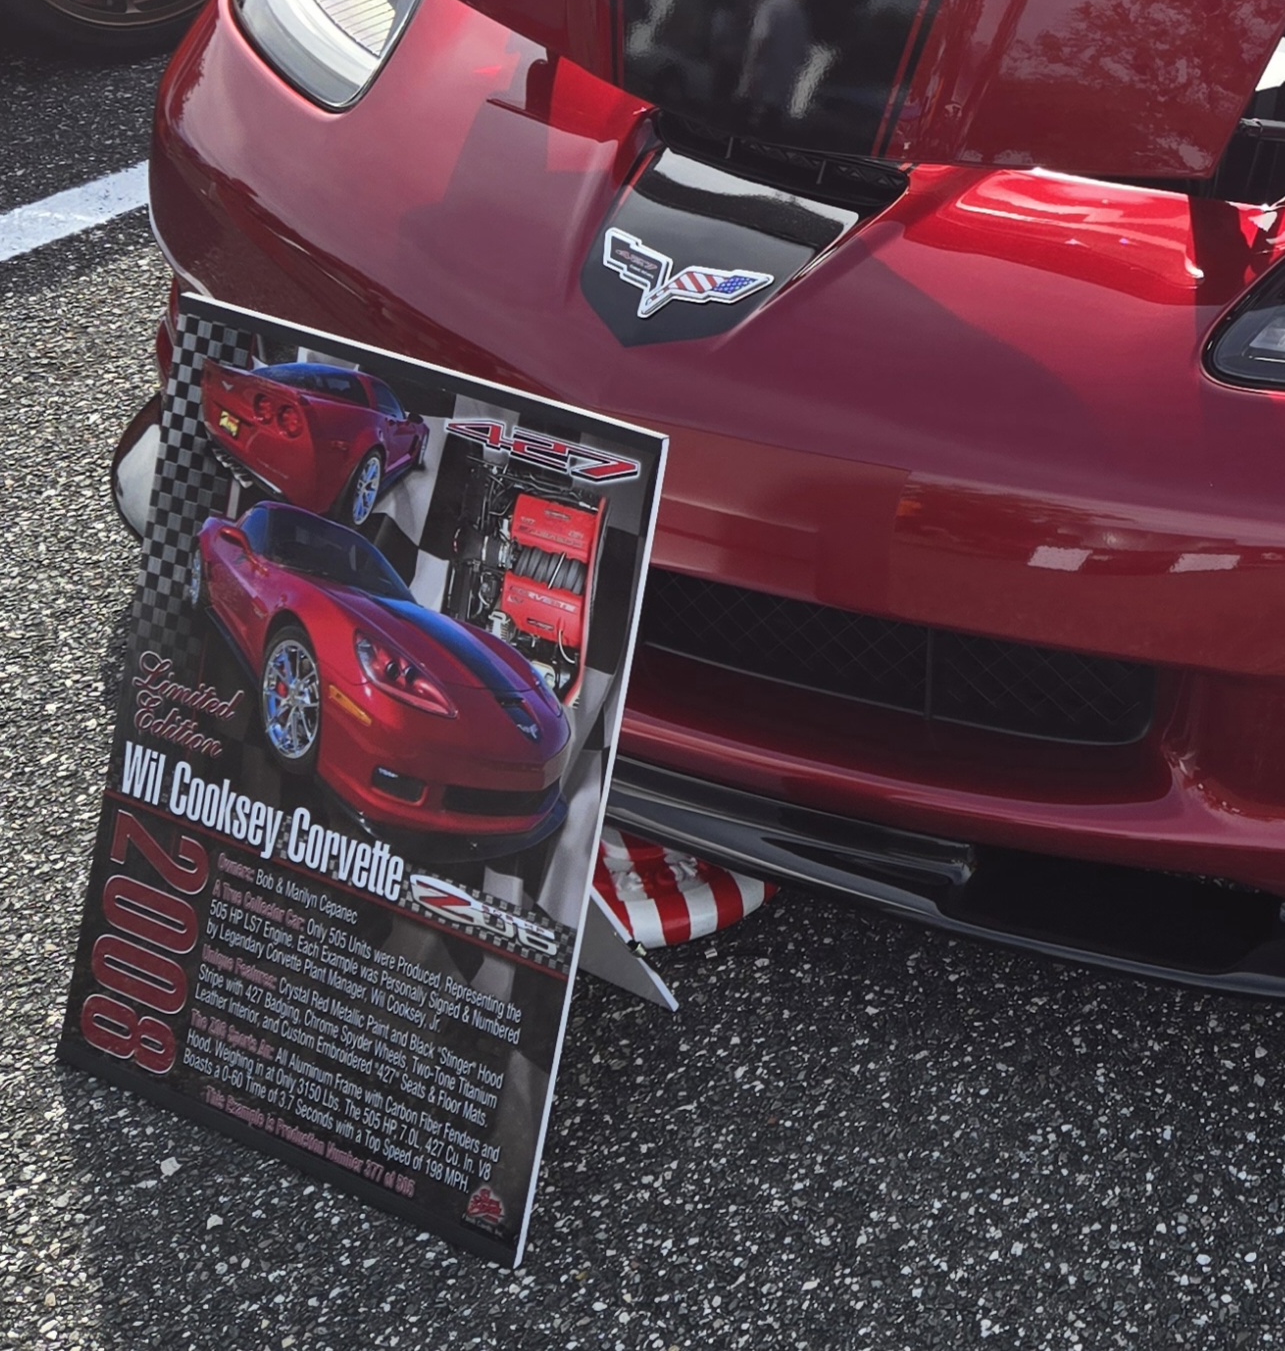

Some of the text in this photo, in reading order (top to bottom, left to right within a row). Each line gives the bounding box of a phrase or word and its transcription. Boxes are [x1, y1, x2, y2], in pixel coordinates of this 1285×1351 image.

[446, 419, 640, 483] 427
[132, 651, 244, 718] Limited
[134, 690, 222, 756] Edition
[122, 742, 404, 901] Wil Cooksey Corvette
[81, 808, 210, 1075] 2008
[212, 879, 222, 898] A
[223, 882, 243, 906] True
[244, 891, 286, 923] Collector
[307, 918, 329, 944] Only
[328, 927, 348, 949] 505
[348, 935, 372, 960] Units
[374, 950, 396, 970] were
[445, 976, 506, 1020] Representing
[506, 1003, 522, 1024] the
[256, 869, 275, 891] Bob
[276, 877, 284, 895] &
[285, 881, 319, 909] Marilyn
[319, 895, 358, 925] Cepanec
[409, 873, 557, 956] Z06
[198, 964, 225, 989] Stripe
[226, 978, 245, 997] with
[245, 984, 265, 1005] 427
[304, 1009, 340, 1039] Chrome
[340, 1025, 373, 1053] Spyder
[374, 1040, 409, 1072] Wheels,
[412, 1056, 457, 1091] Two-Tone
[459, 1077, 498, 1109] Titanium
[206, 918, 220, 940] by
[219, 924, 266, 959] Legendary
[266, 943, 303, 973] Corvette
[303, 959, 328, 984] Plant
[327, 969, 368, 1003] Manager,
[371, 988, 386, 1008] Wil
[429, 1014, 442, 1033] Jr.
[210, 899, 521, 1045] 505 HP LS7 Engine. Each Example was Personally Signed & Numbered
[279, 977, 311, 1005] Crystal
[311, 991, 331, 1013] Red
[330, 999, 366, 1029] Metallic
[366, 1015, 391, 1040] Paint
[390, 1029, 410, 1048] and
[409, 1034, 436, 1059] Black
[436, 1047, 478, 1078] "Stinger"
[477, 1064, 505, 1090] Hood
[187, 1029, 212, 1054] Hood.
[215, 1040, 255, 1076] Weighing
[255, 1059, 265, 1077] in
[265, 1066, 276, 1083] at
[276, 1069, 298, 1094] Only
[297, 1078, 323, 1103] 3150
[322, 1089, 341, 1113] Lbs.
[345, 1098, 362, 1121] The
[362, 1107, 382, 1130] 505
[382, 1116, 399, 1141] HP,
[425, 1137, 446, 1158] 427
[445, 1146, 461, 1168] Cu.
[463, 1153, 475, 1174] In.
[479, 1160, 492, 1182] V8
[195, 983, 229, 1010] Leather
[228, 998, 261, 1028] Interior,
[262, 1015, 281, 1034] and
[281, 1021, 316, 1050] Custom
[316, 1036, 374, 1075] Embroidered
[400, 1074, 427, 1100] Seats
[428, 1086, 437, 1104] &
[437, 1091, 463, 1115] Floor
[462, 1101, 488, 1128] Mats.
[275, 1047, 289, 1067] All
[288, 1054, 334, 1086] Aluminum
[334, 1073, 364, 1101] Frame
[365, 1090, 384, 1110] with
[385, 1096, 419, 1125] Carbon
[419, 1112, 444, 1136] Fiber
[443, 1122, 481, 1154] Fenders
[481, 1143, 501, 1163] and
[183, 1048, 469, 1194] Boasts a 0-60 Time of 3.7 Seconds with a Top Speed of 198 MPH.
